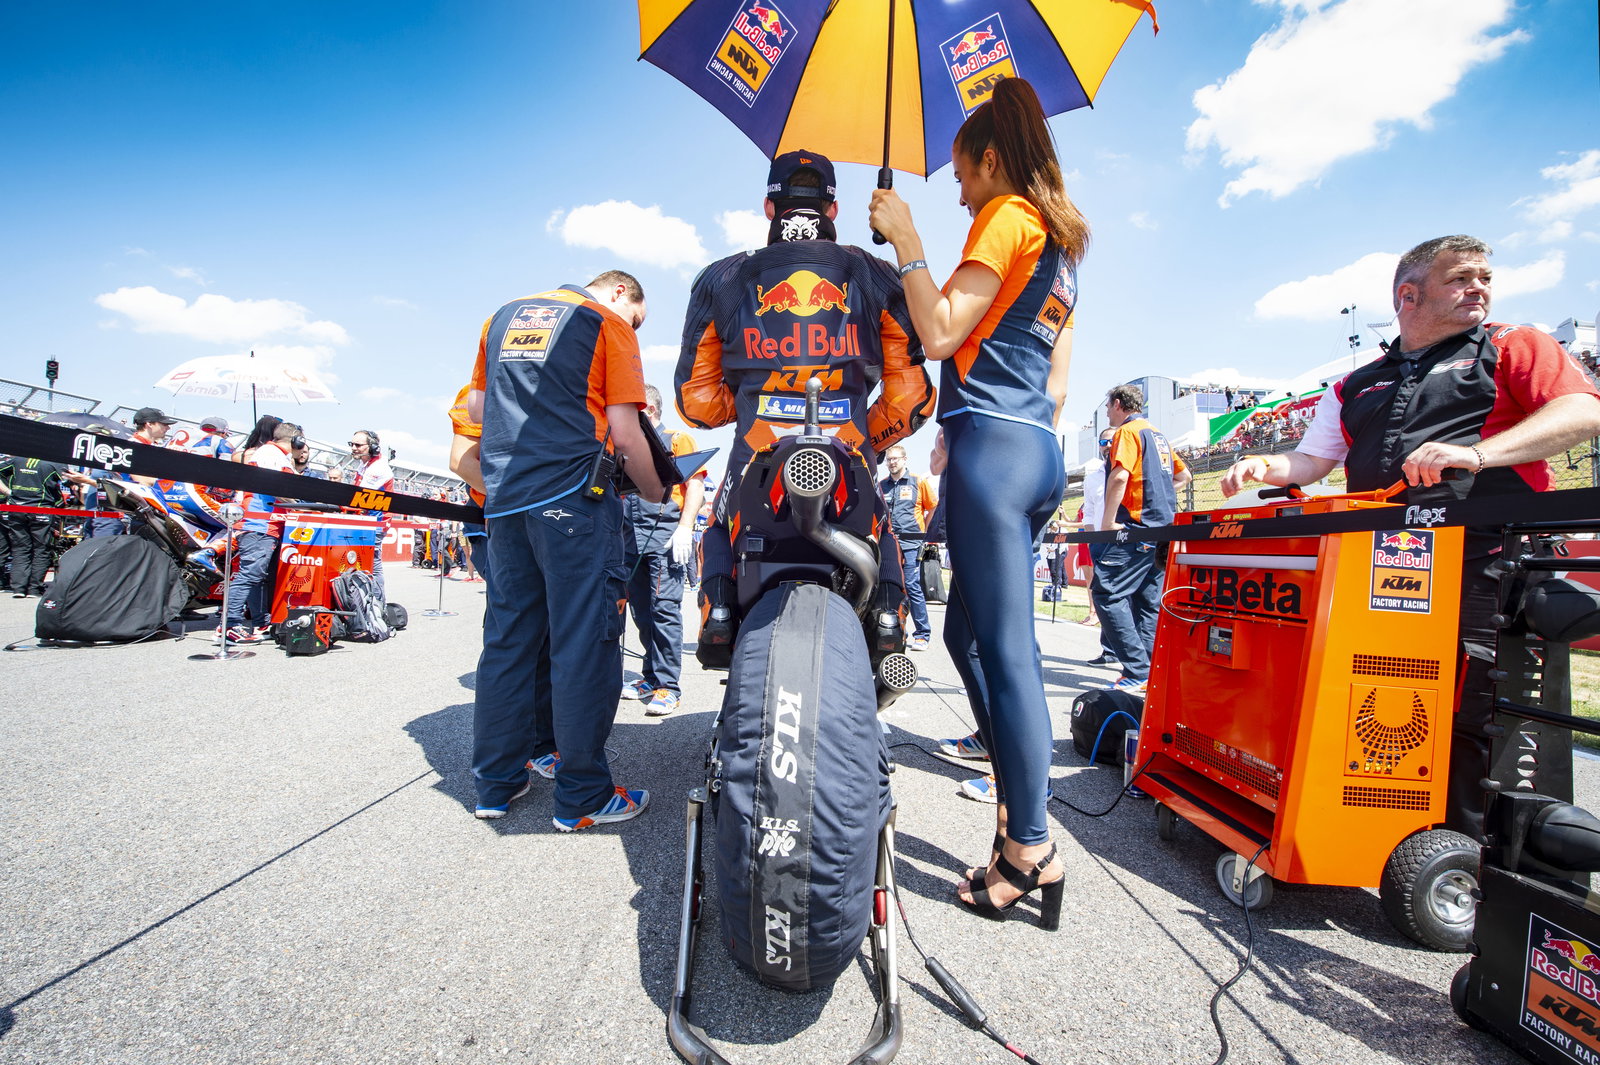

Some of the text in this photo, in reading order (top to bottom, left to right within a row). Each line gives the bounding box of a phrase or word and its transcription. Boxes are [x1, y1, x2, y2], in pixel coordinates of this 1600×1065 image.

[1043, 305, 1061, 326] KTM
[510, 333, 544, 345] KTM
[743, 322, 861, 360] Red Bull
[761, 365, 844, 392] KTM
[72, 433, 133, 470] flex
[349, 488, 393, 512] KTM
[1405, 505, 1447, 528] flex
[288, 526, 315, 543] 43
[1209, 521, 1245, 539] KTM
[1375, 549, 1431, 569] Red Bull
[1216, 569, 1302, 615] Beta
[1381, 575, 1422, 591] KTM
[1372, 597, 1428, 610] FACTORY RACING
[771, 685, 802, 784] KLS
[765, 905, 792, 972] KLS
[1531, 947, 1578, 992] Red
[1525, 1012, 1572, 1050] FACTORY
